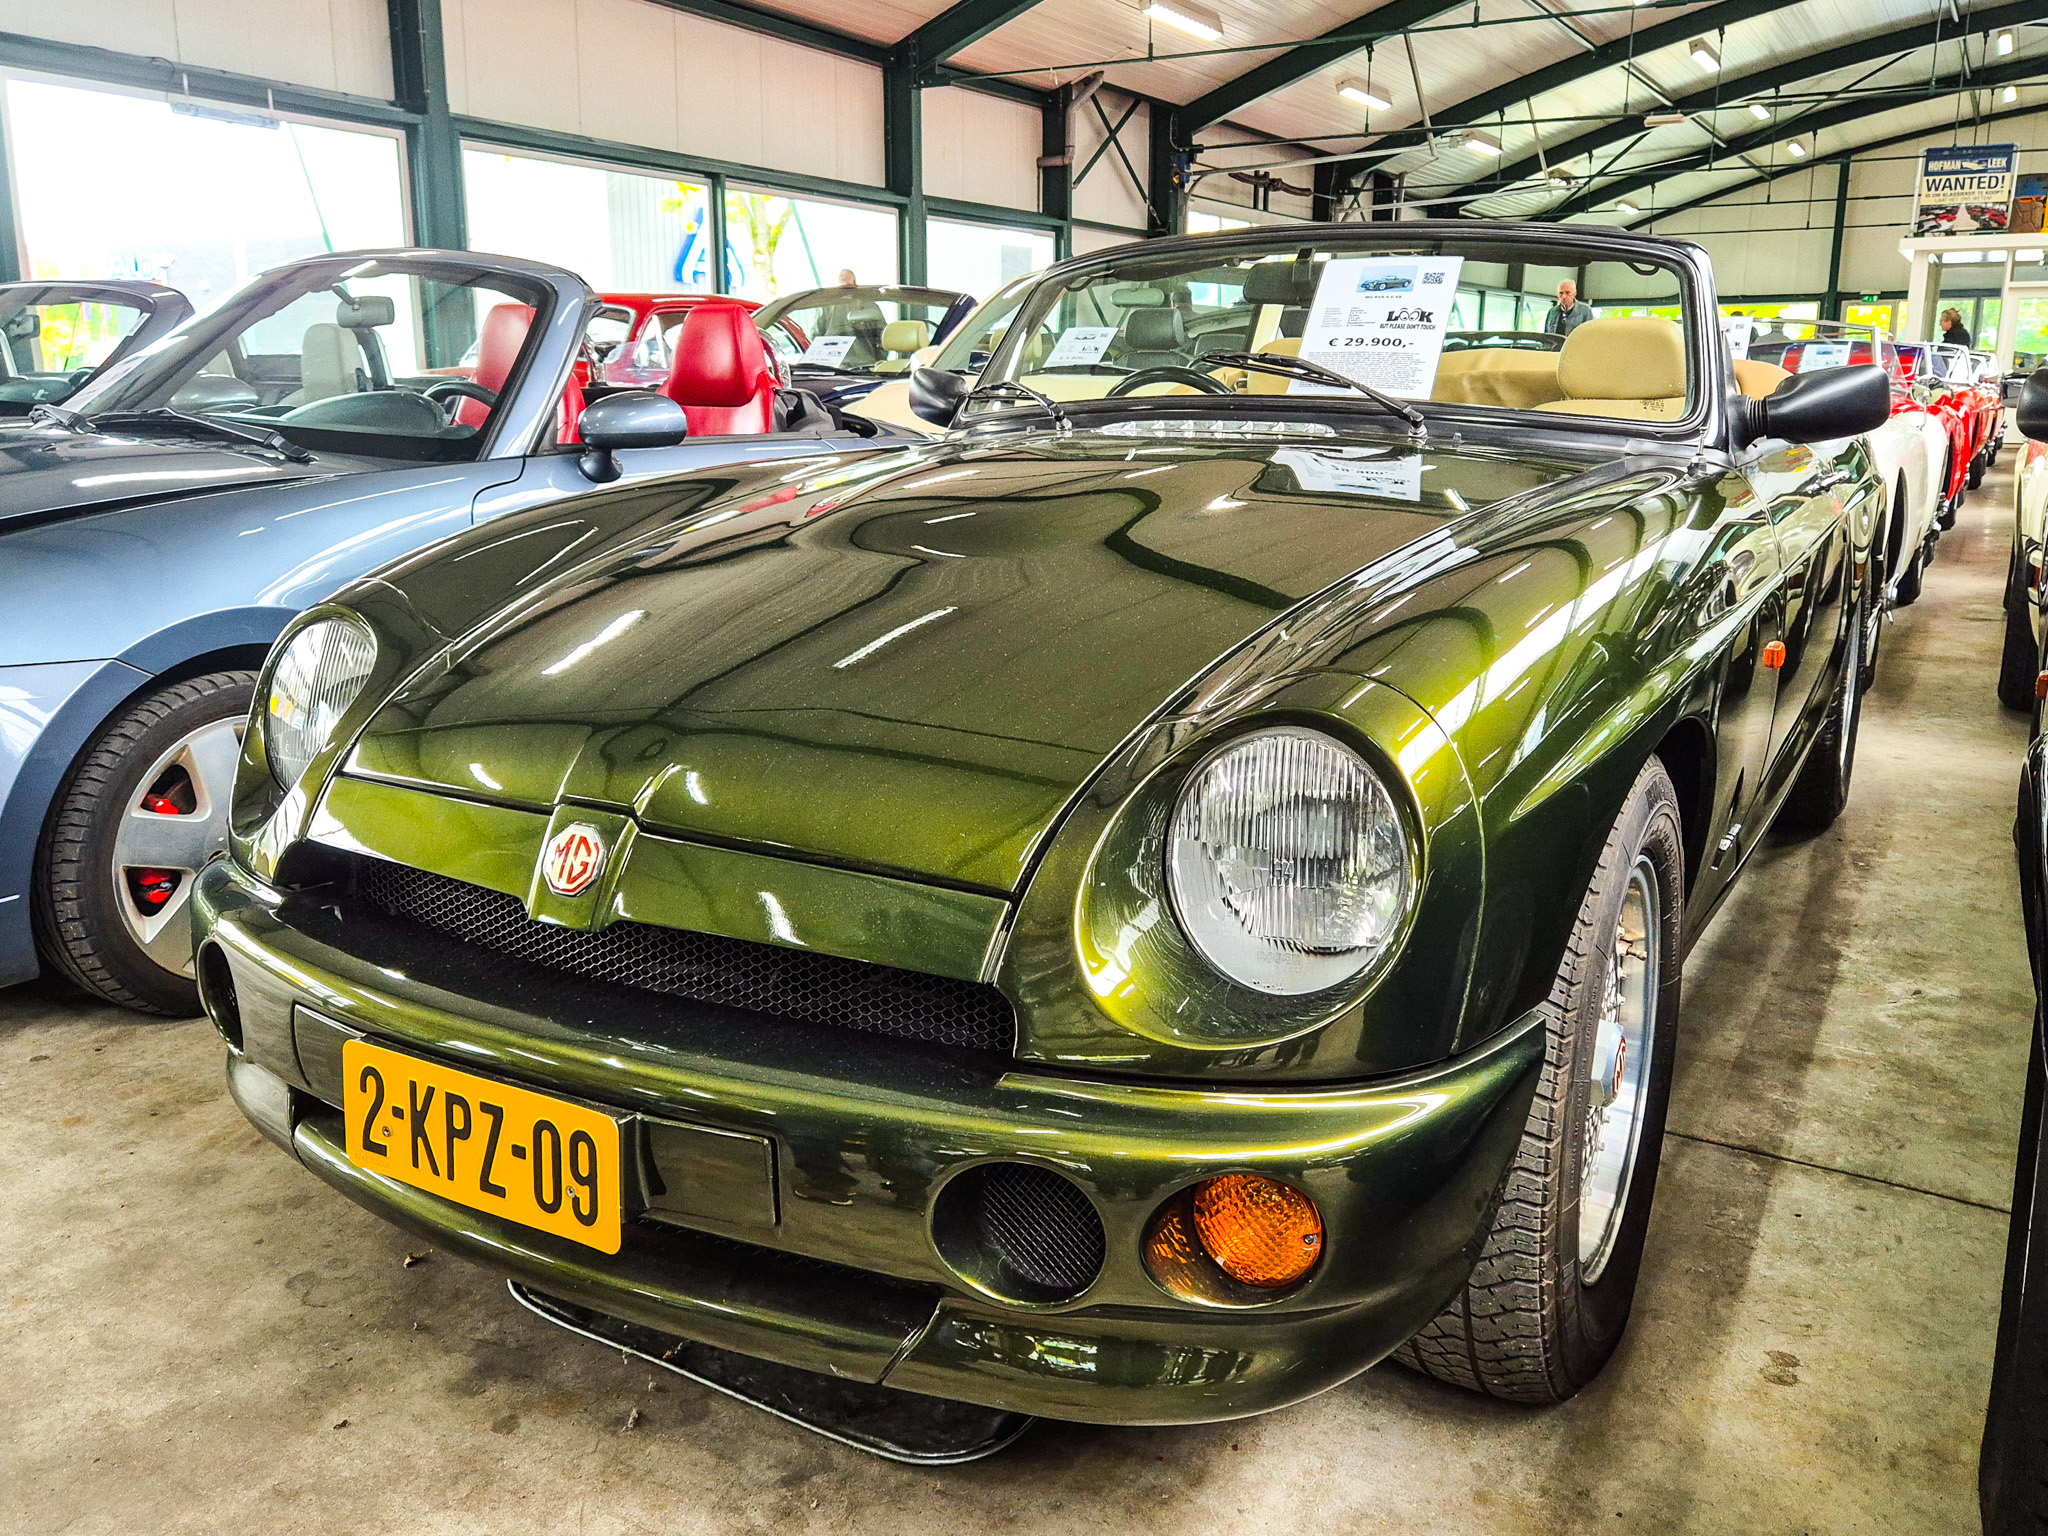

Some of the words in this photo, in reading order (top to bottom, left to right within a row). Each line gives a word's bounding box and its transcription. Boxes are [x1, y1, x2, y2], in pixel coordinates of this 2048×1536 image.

[1928, 160, 1962, 172] HOFMAN
[1988, 157, 2008, 168] LEEK
[1926, 175, 2006, 192] WANTED!
[1386, 308, 1434, 323] LOOK
[1328, 338, 1339, 347] €
[1344, 337, 1414, 349] 29.900,-
[552, 833, 593, 885] MG
[360, 1065, 599, 1227] 2-KPZ-09
